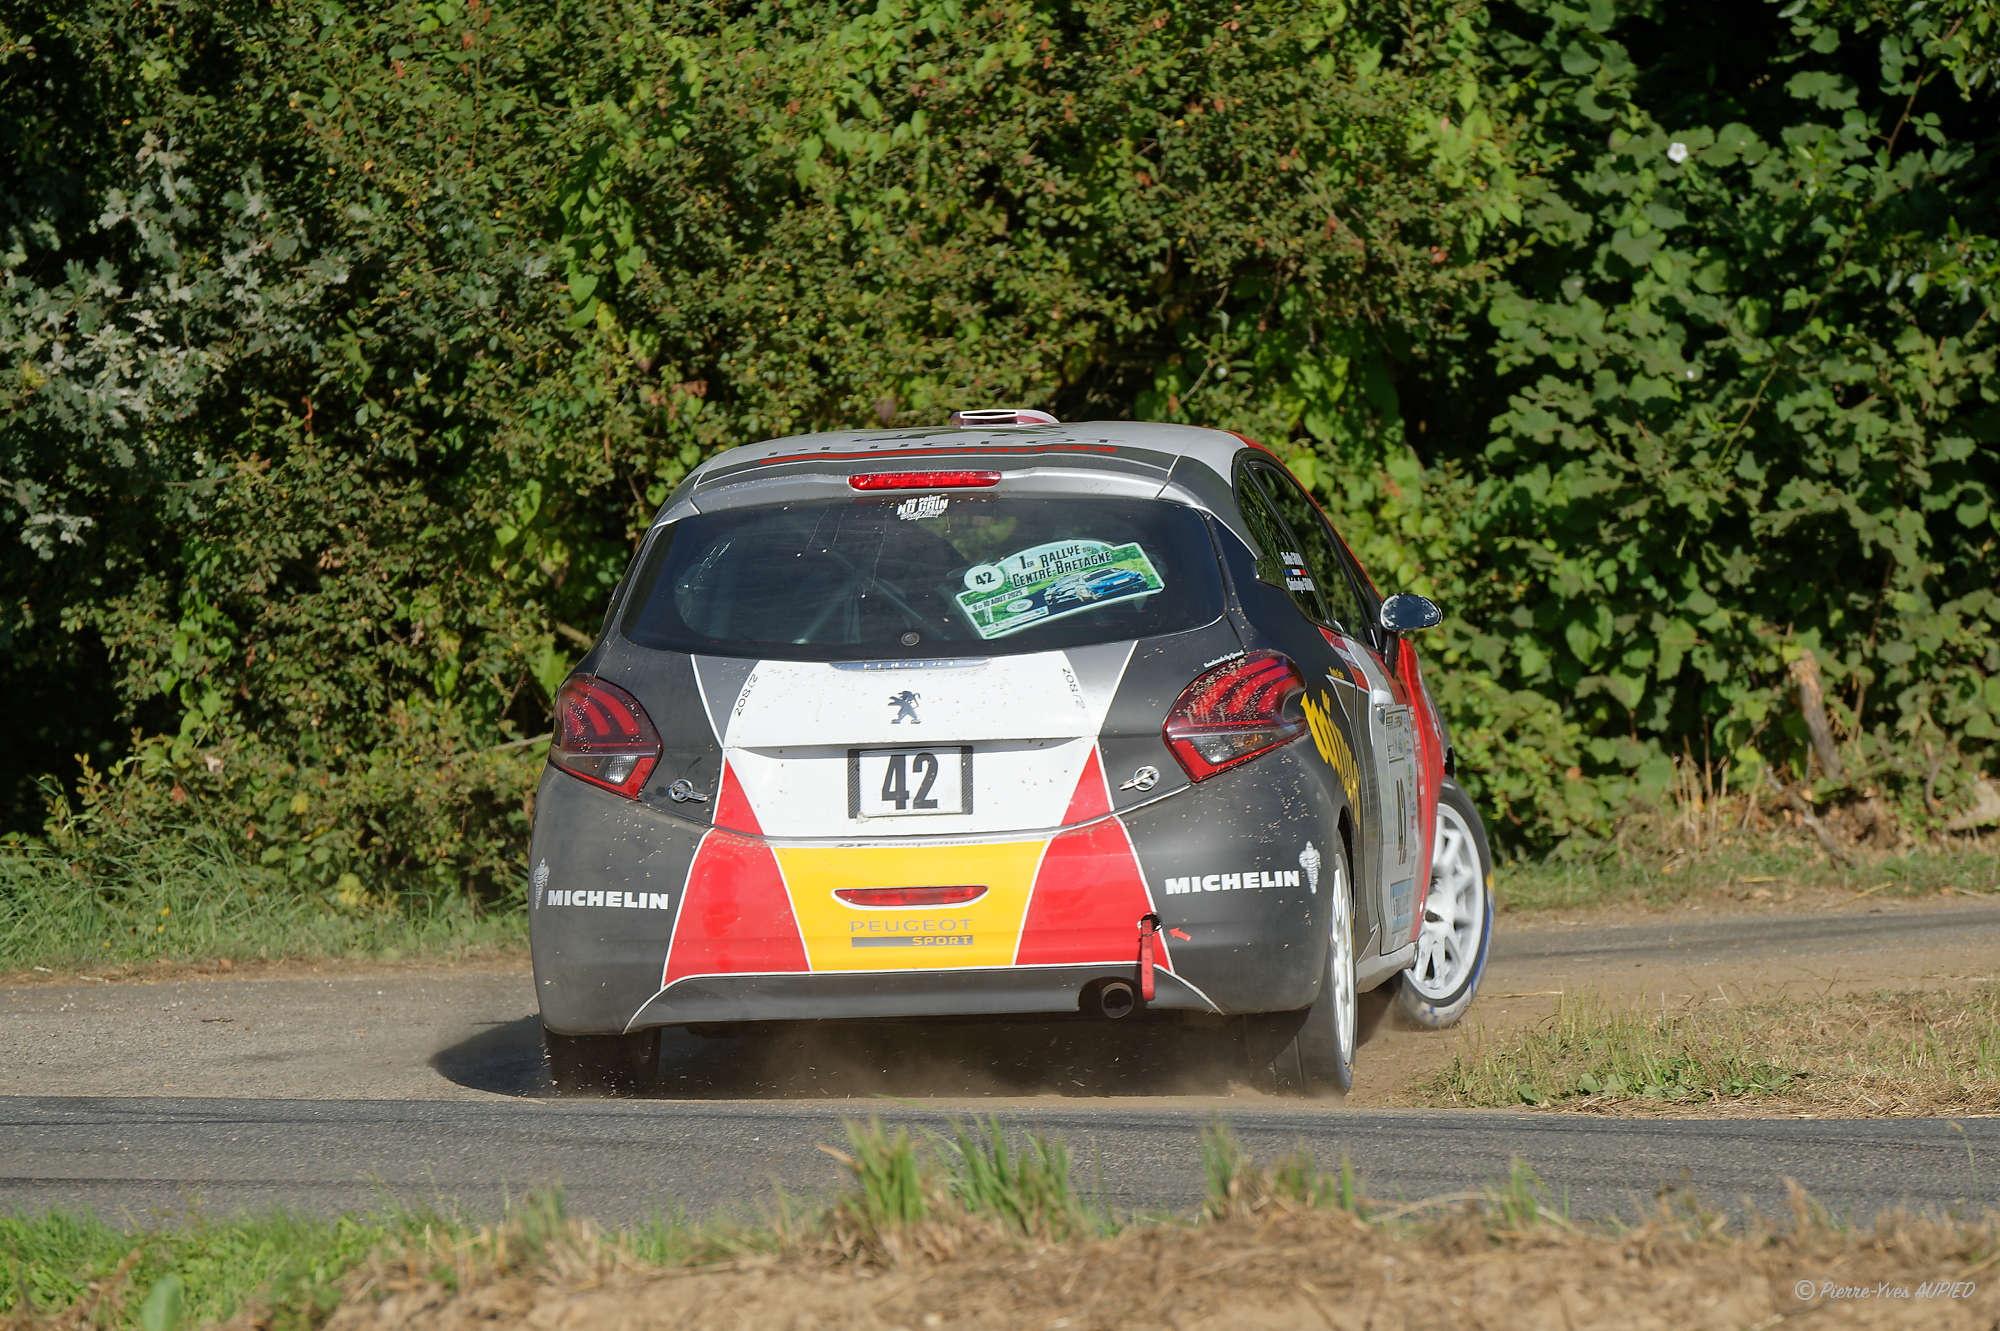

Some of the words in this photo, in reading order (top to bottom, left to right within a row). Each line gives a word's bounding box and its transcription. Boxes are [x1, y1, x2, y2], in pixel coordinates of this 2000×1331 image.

[1040, 545, 1081, 569] RALLYE
[975, 571, 996, 585] 42
[1011, 551, 1113, 588] CENTRE-BRETAGNE
[881, 752, 939, 810] 42
[1164, 870, 1300, 895] MICHELIN
[547, 889, 669, 910] MICHELIN
[850, 918, 973, 933] PEUGEOT
[911, 936, 971, 946] SPORT
